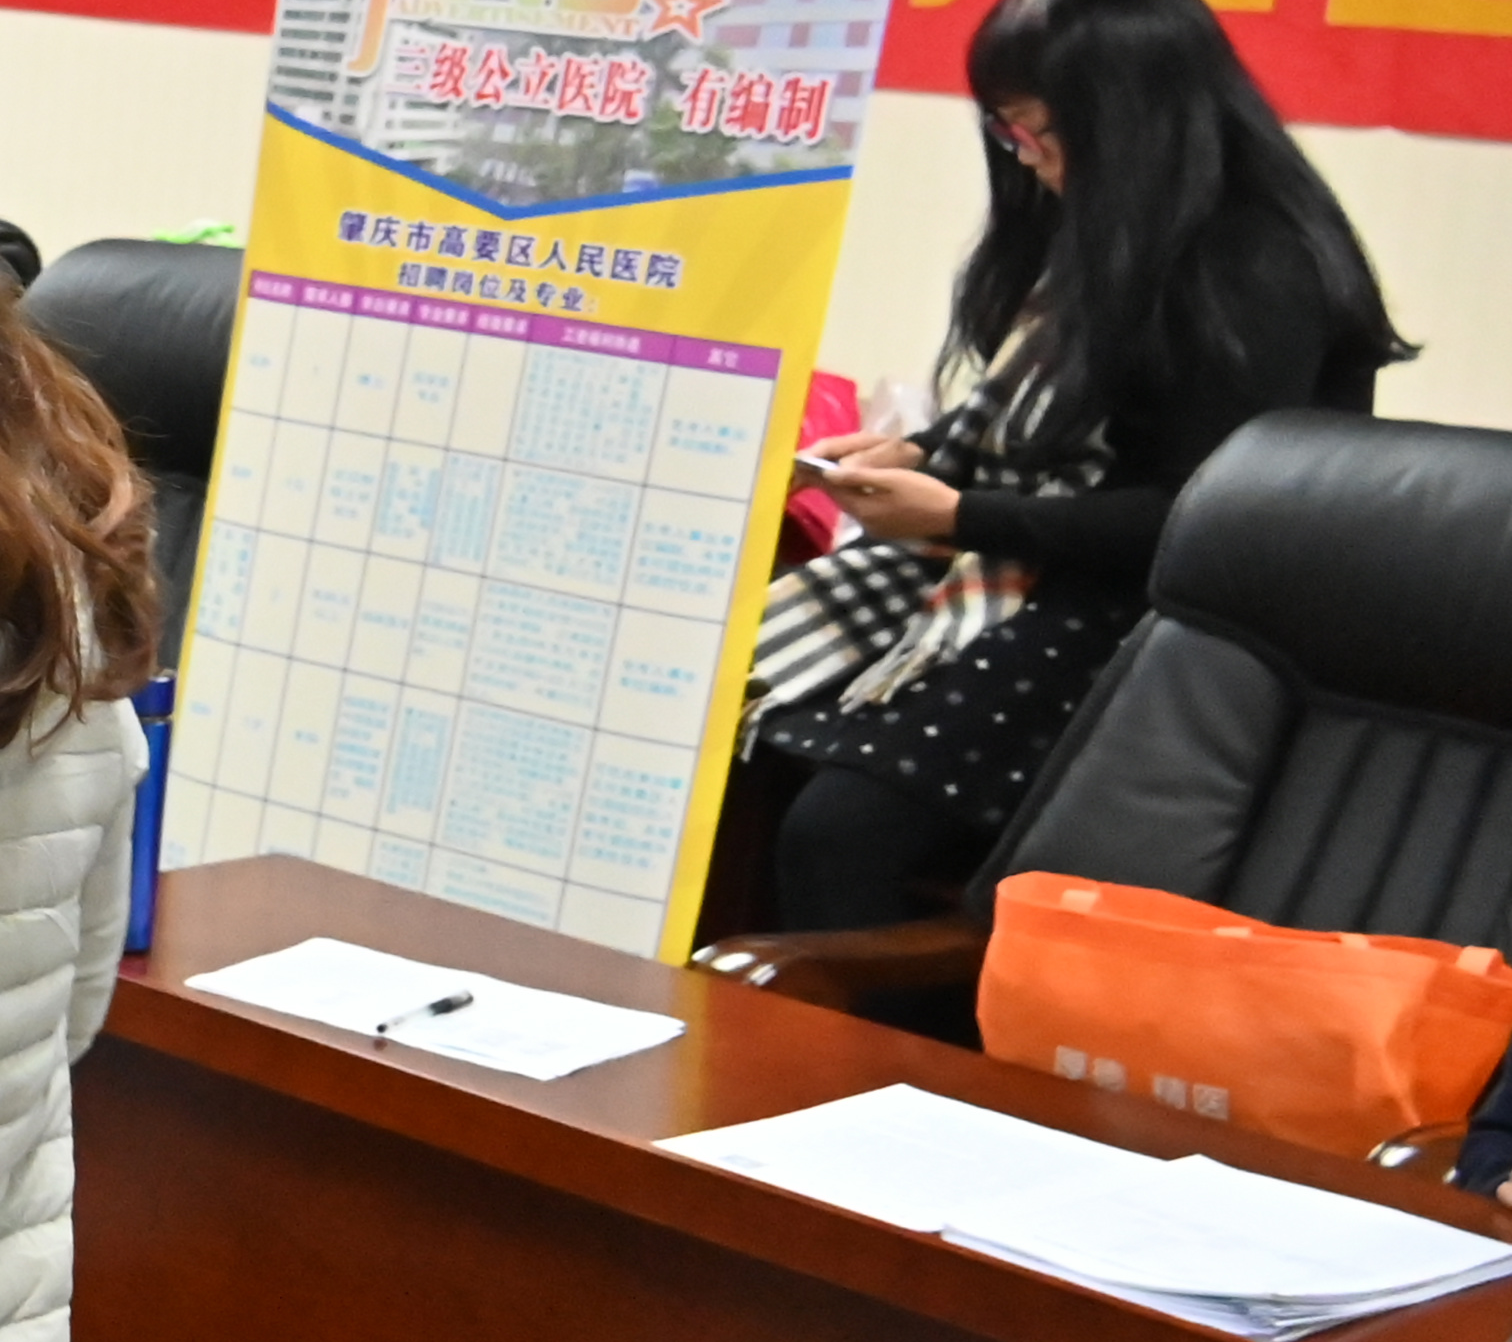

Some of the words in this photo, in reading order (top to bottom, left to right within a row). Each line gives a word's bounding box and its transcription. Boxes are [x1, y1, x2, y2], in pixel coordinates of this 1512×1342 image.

[384, 41, 650, 122] 三级公立医院
[681, 70, 829, 141] 有编制
[337, 209, 682, 290] 肇庆市高要区人民医院
